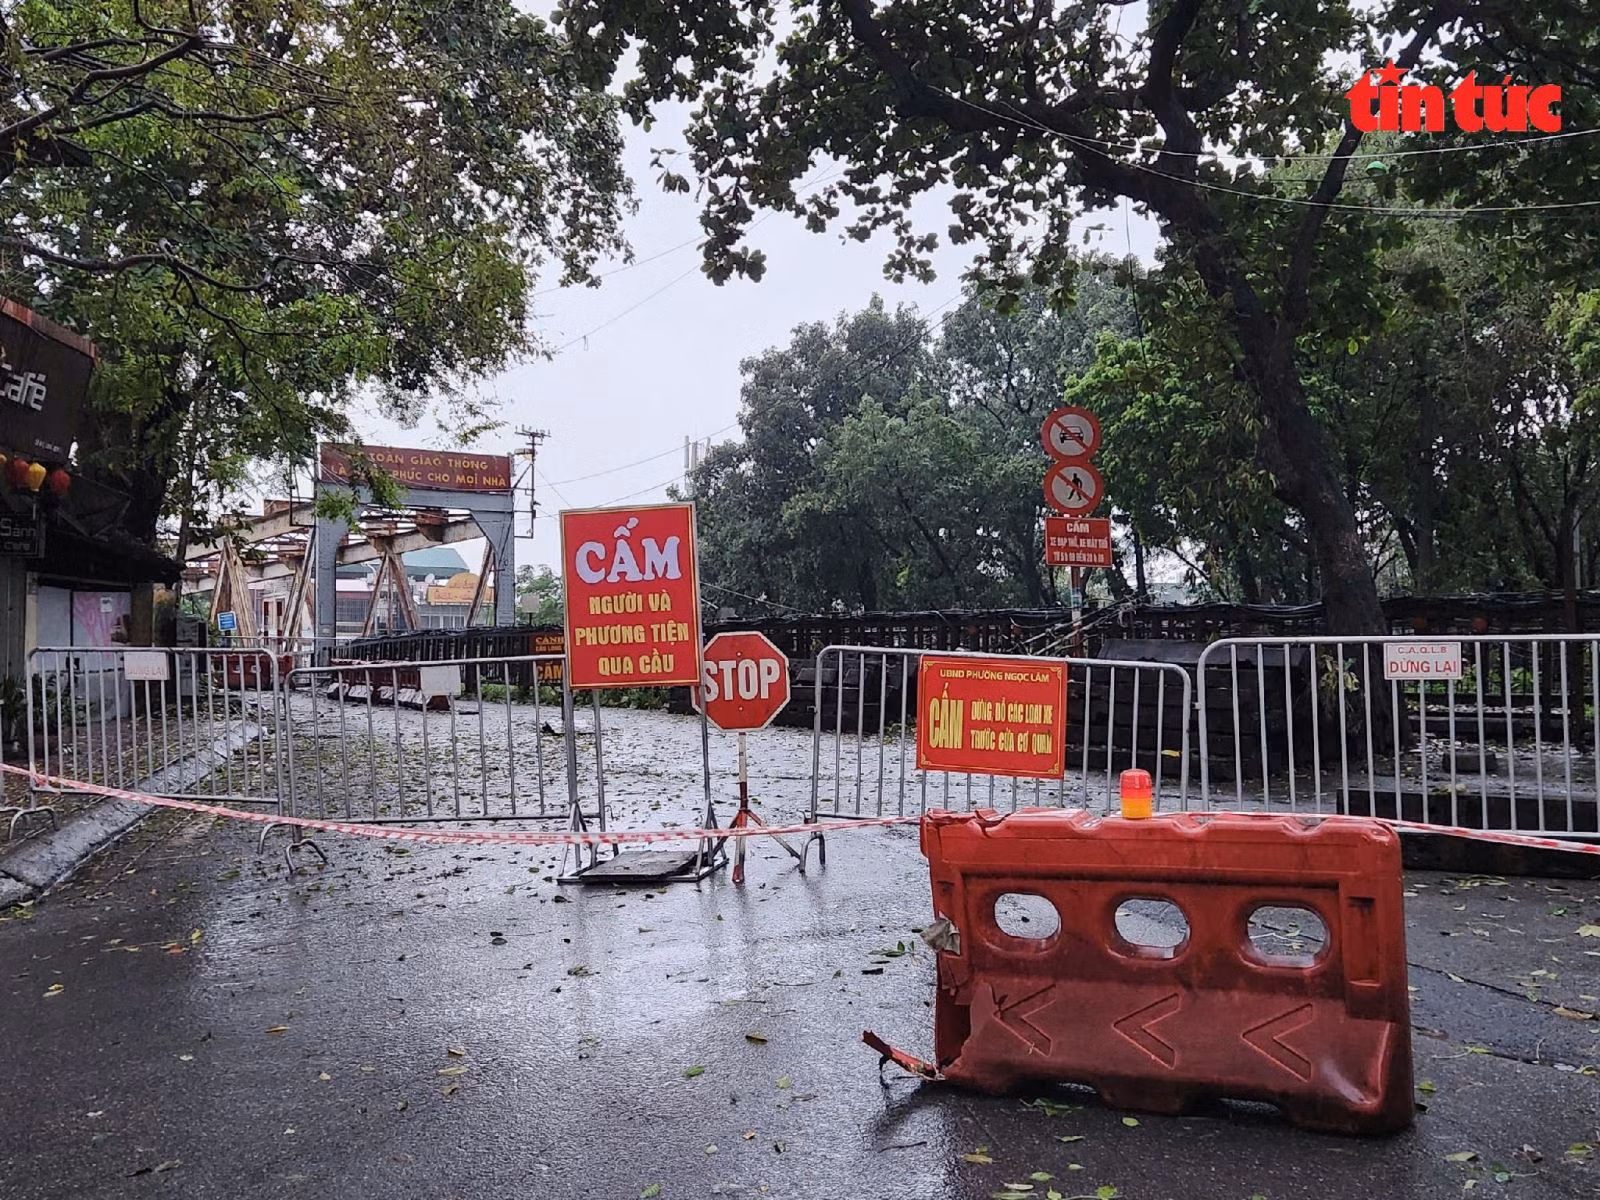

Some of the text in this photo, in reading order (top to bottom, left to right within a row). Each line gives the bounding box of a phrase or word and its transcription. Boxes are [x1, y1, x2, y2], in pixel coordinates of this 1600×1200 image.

[447, 456, 489, 470] THÔNG
[427, 472, 450, 483] CHO
[483, 474, 506, 487] NHÀ
[575, 516, 682, 584] CẤM
[589, 589, 672, 615] NGƯỜI VÀ
[575, 620, 689, 646] PHƯƠNG TIỆN
[598, 648, 675, 676] QUA CẦU
[1389, 657, 1457, 676] DỪNG LẠI
[703, 658, 780, 702] STOP
[940, 669, 964, 678] UBND
[966, 669, 1003, 680] PHƯỜNG
[1004, 672, 1029, 683] NGỌC
[929, 682, 964, 749] CẤM
[1043, 704, 1054, 725] XE
[1017, 730, 1029, 753] CƠ
